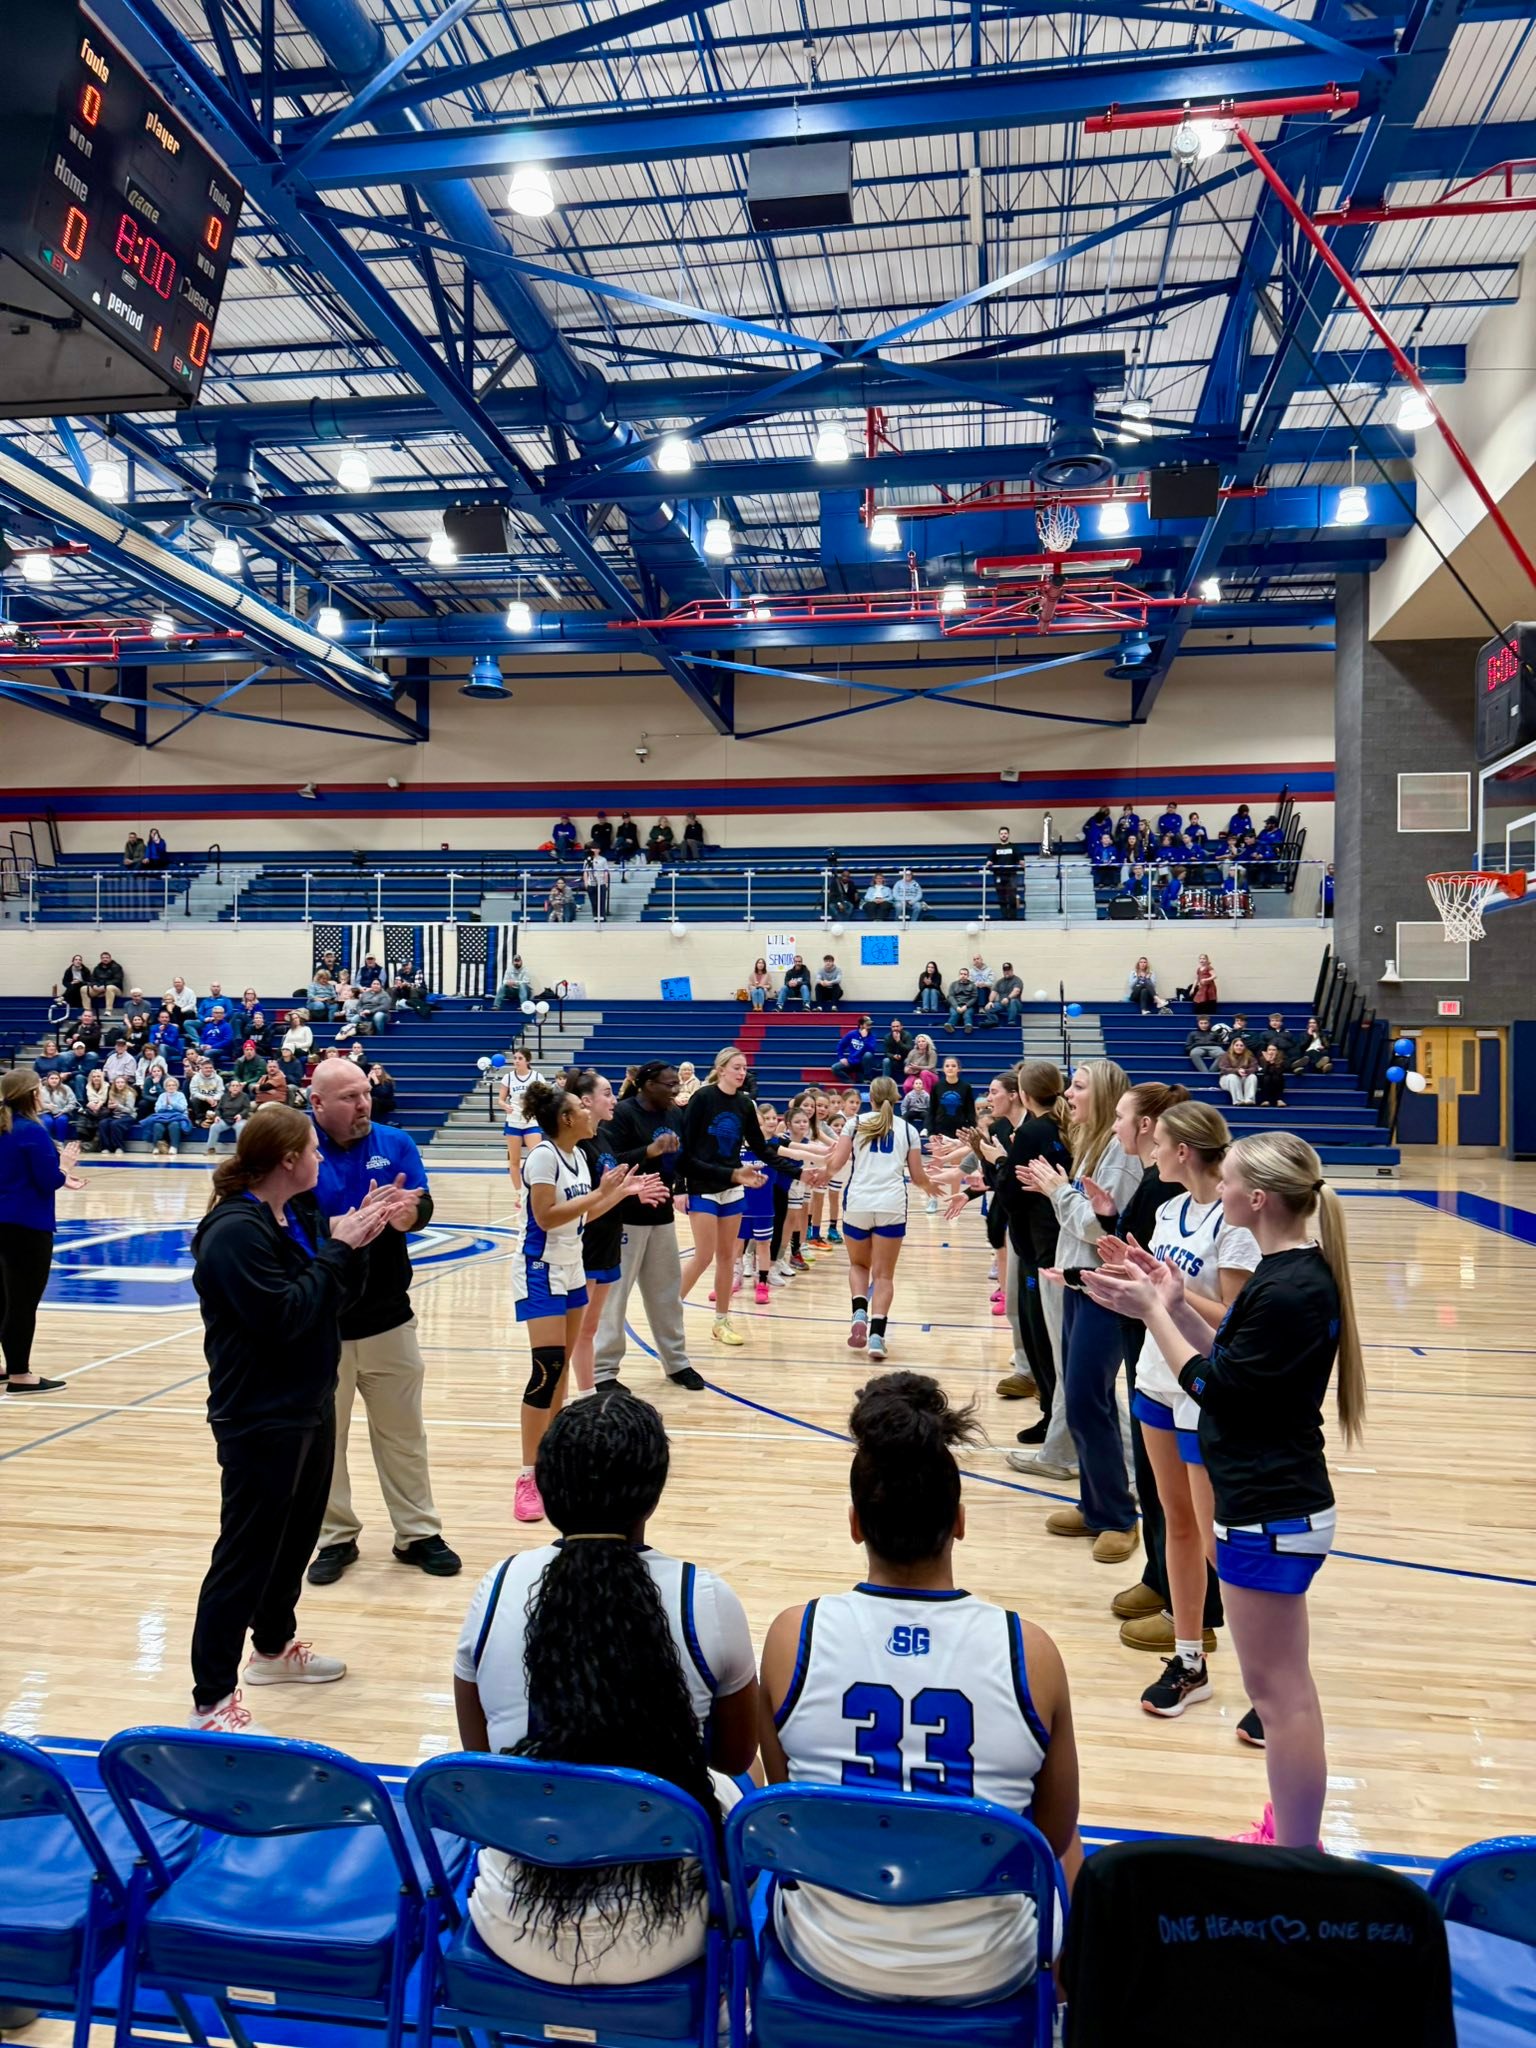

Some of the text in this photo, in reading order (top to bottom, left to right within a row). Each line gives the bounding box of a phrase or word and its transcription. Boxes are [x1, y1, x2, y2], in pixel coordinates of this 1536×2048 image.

[81, 38, 109, 83] fouls
[83, 85, 101, 126] 0
[69, 124, 93, 158] won
[145, 112, 180, 154] player
[54, 153, 88, 202] Home
[209, 180, 231, 215] fouls
[62, 207, 87, 260] 0
[207, 216, 223, 250] 0
[197, 252, 216, 280] won
[107, 292, 144, 332] period
[190, 322, 210, 367] 0
[1153, 1244, 1204, 1277] OCKETS
[893, 1625, 930, 1656] SG
[842, 1681, 975, 1799] 33
[1159, 1914, 1199, 1944] ONE
[1205, 1914, 1267, 1941] HEART
[1319, 1921, 1360, 1940] ONE
